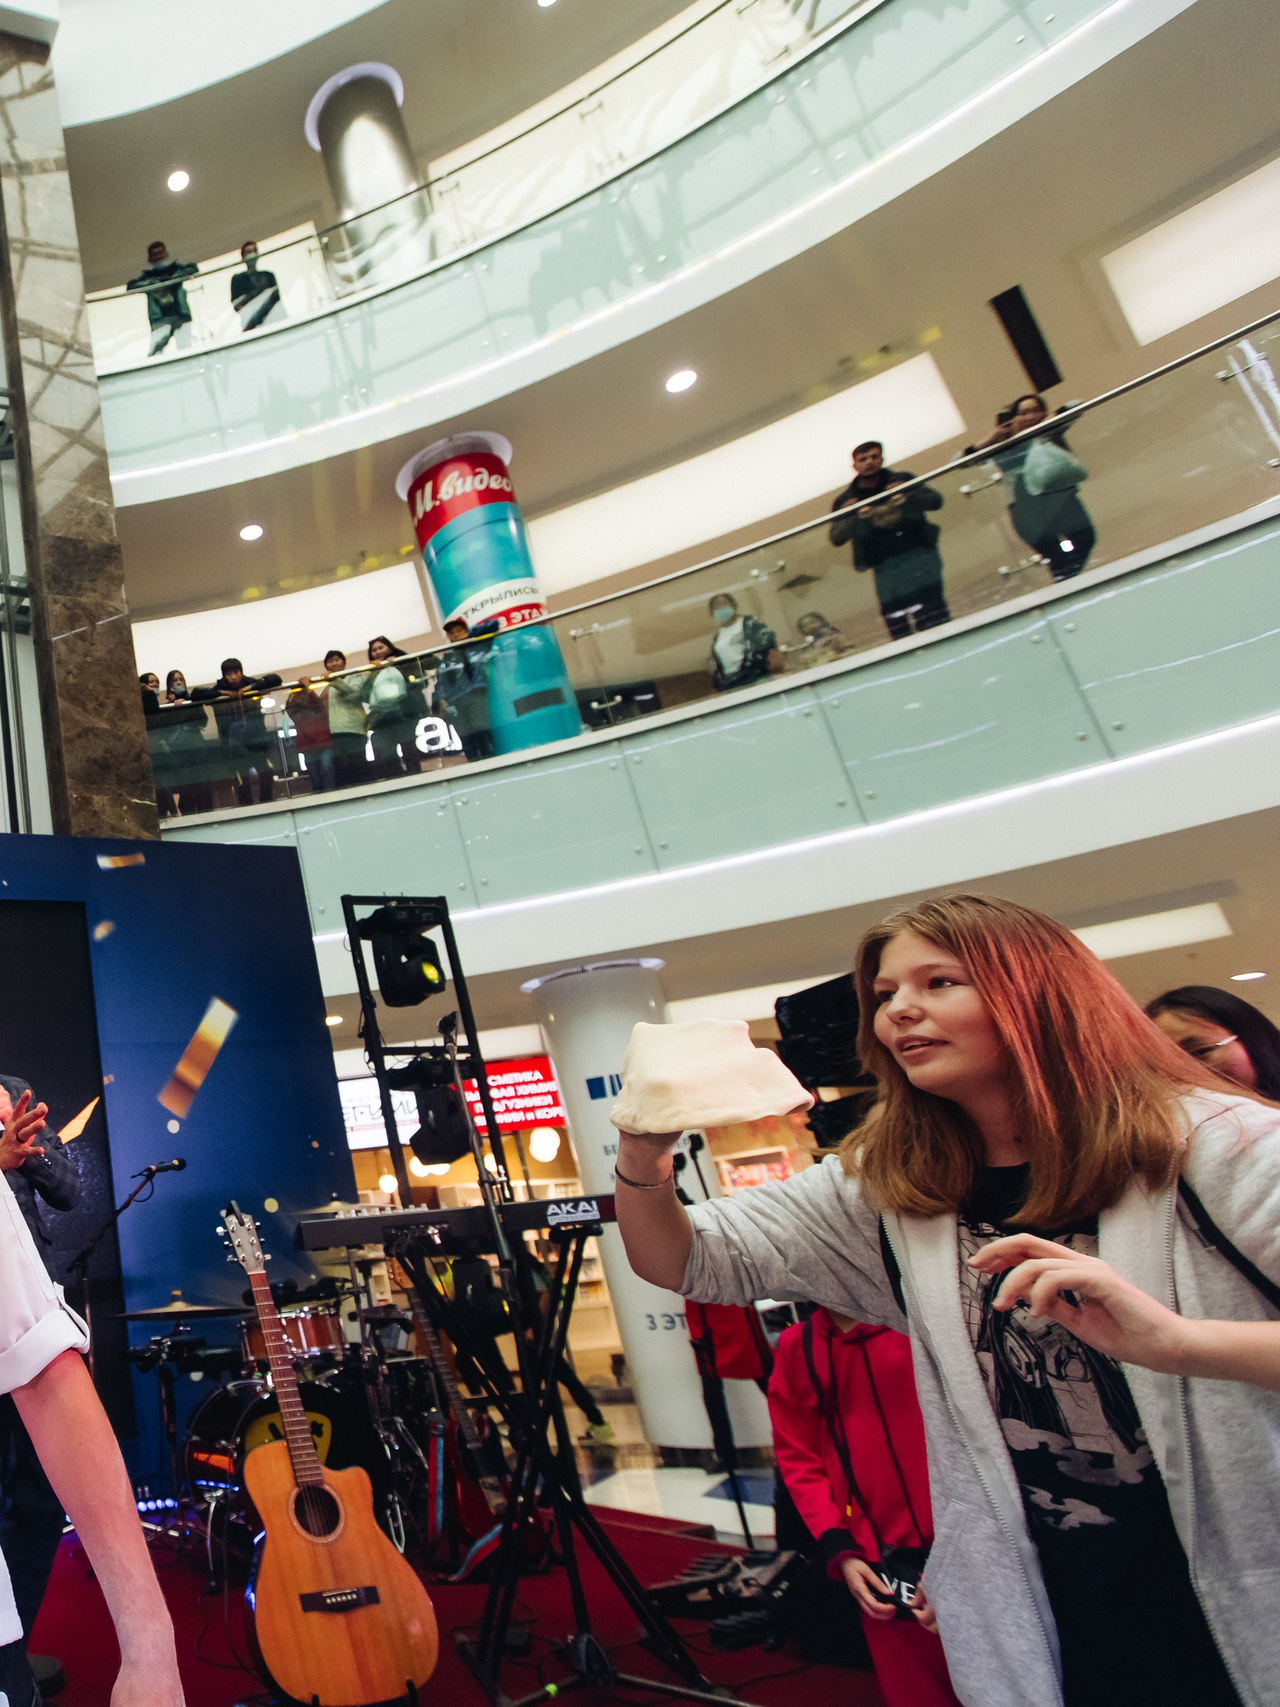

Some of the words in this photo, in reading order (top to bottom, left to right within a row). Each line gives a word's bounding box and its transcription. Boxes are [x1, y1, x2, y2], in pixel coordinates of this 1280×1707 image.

[462, 586, 538, 618] ТКРЫЛИСЬ
[472, 1070, 543, 1088] СМЕТИКА
[474, 1095, 554, 1113] ПДГУЗНИКИ
[547, 1200, 599, 1215] AKAI
[646, 1313, 657, 1331] 3
